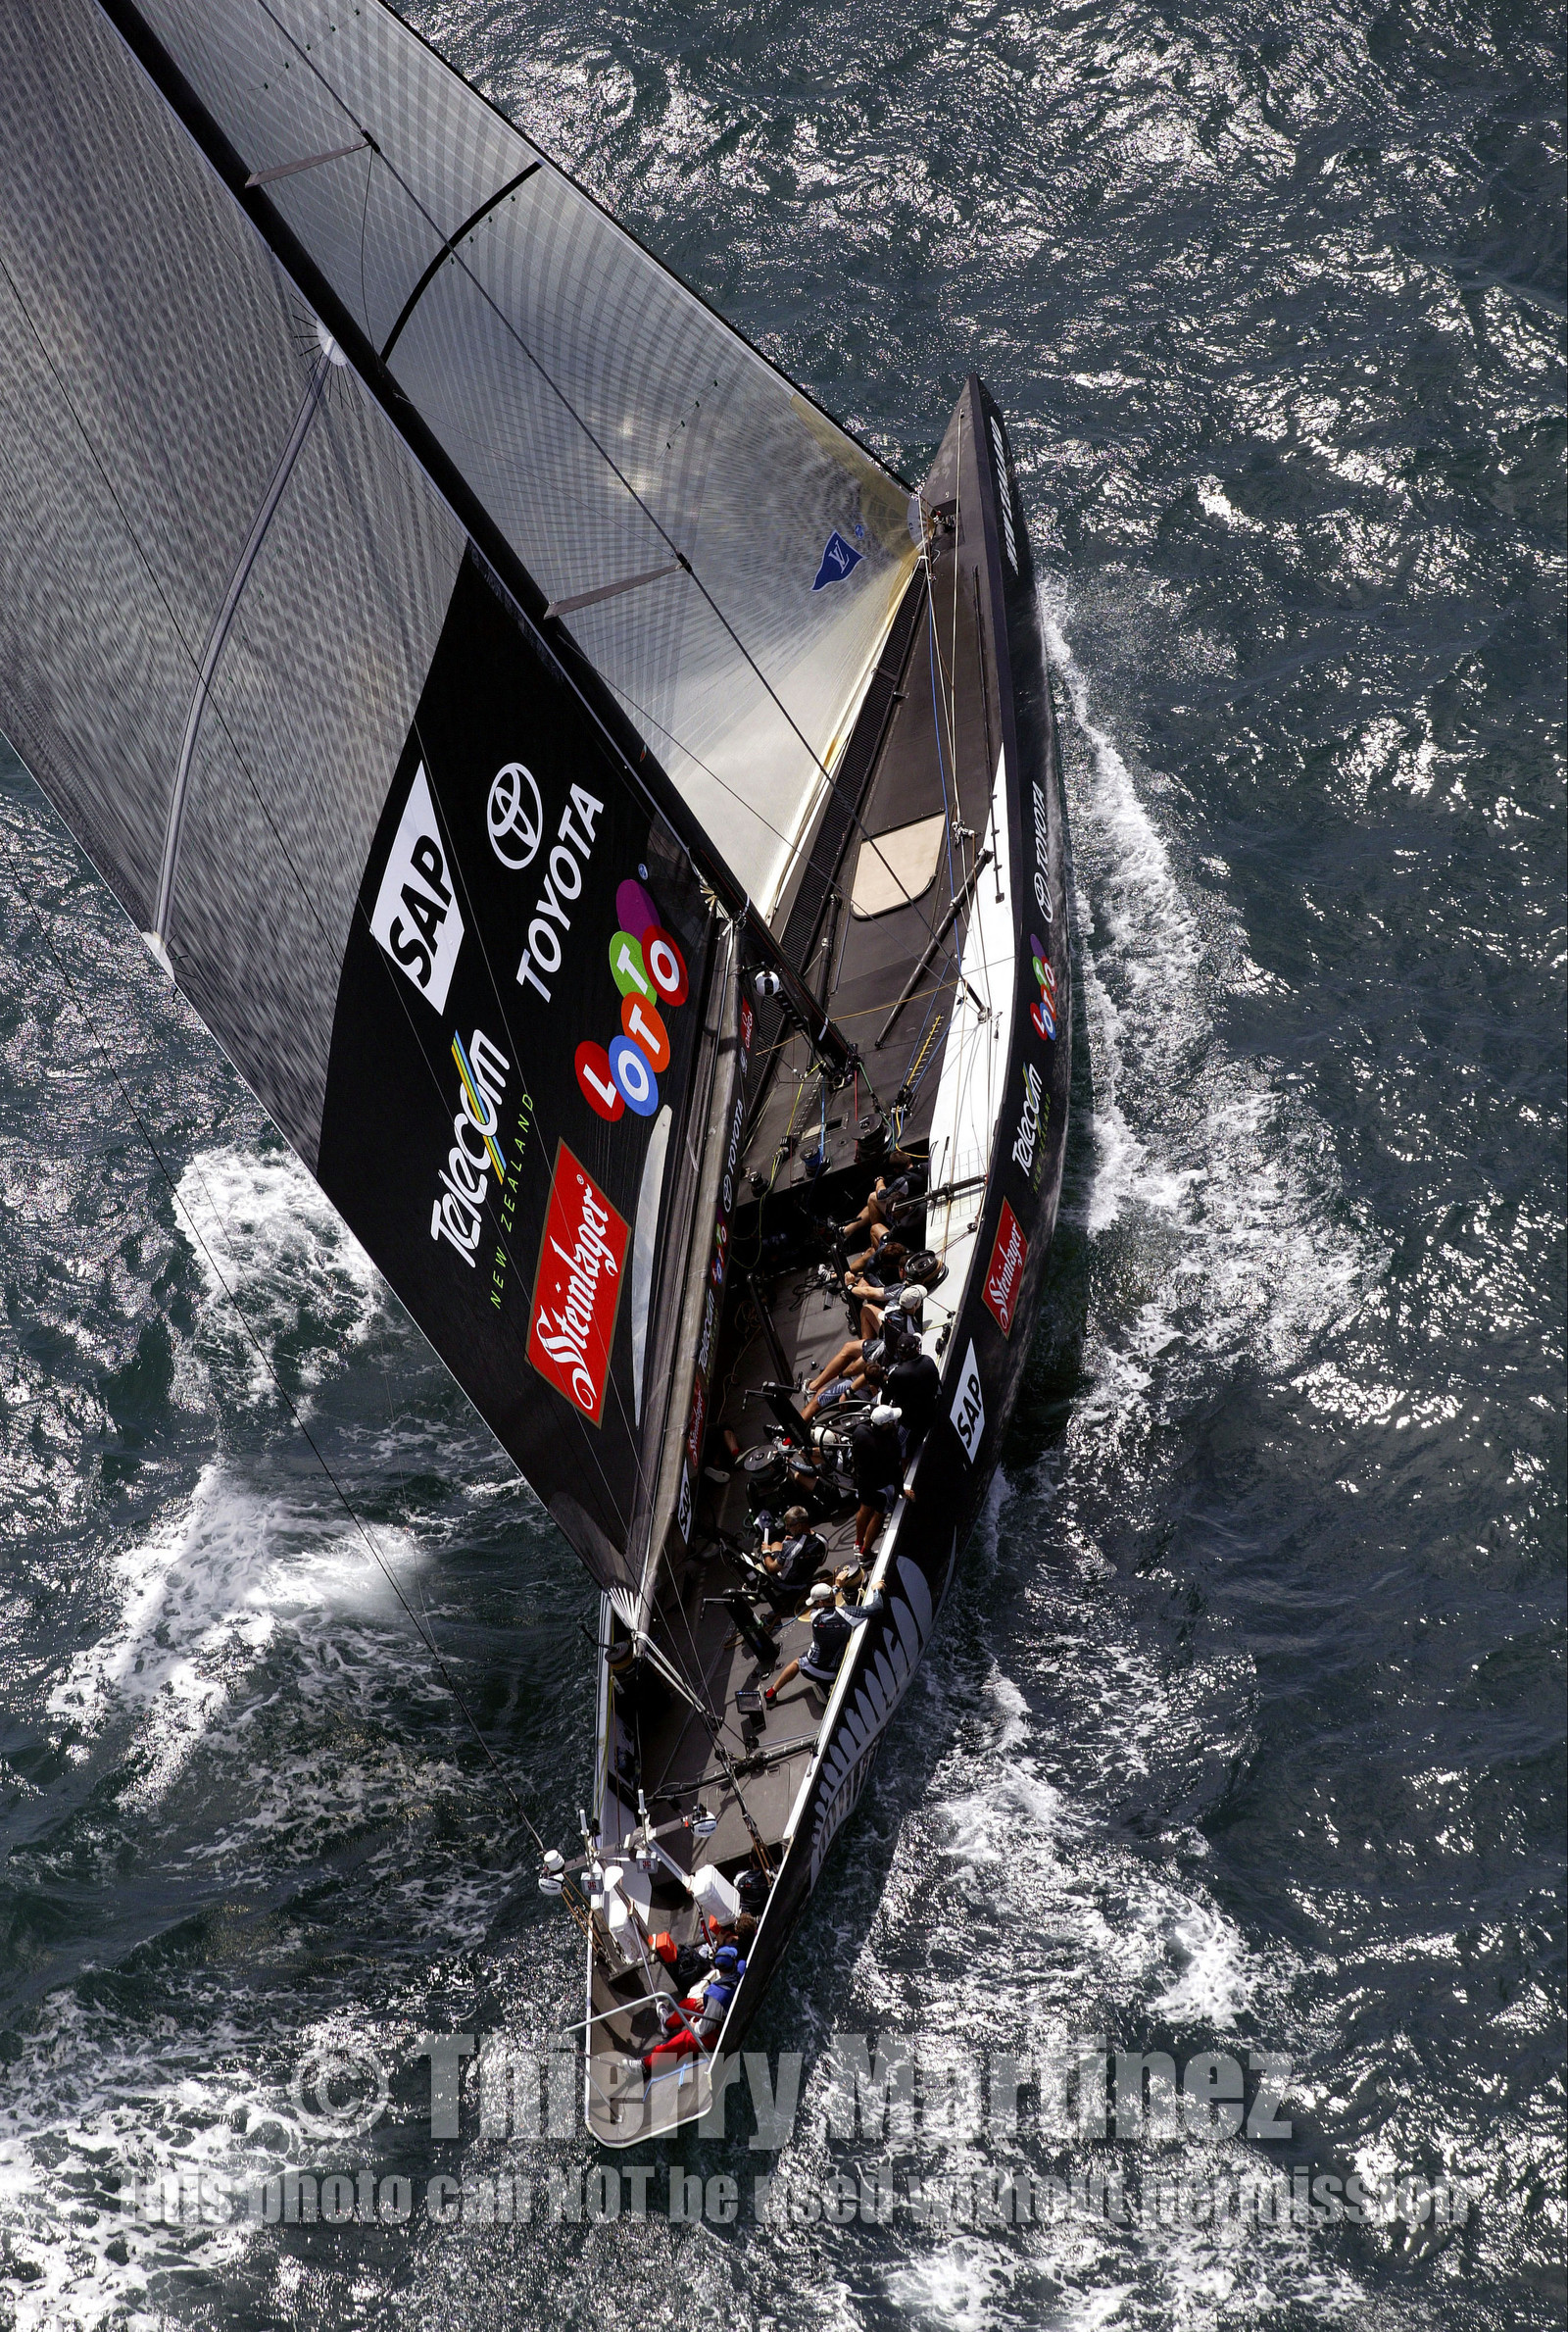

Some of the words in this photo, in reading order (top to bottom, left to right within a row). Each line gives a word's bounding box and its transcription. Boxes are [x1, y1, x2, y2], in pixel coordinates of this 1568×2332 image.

[515, 783, 604, 1003] TOYOTA
[1032, 780, 1049, 876] TOYOTA
[389, 834, 453, 989] SAP
[582, 939, 680, 1110] LOTTO
[1033, 962, 1055, 1034] LOTTO
[430, 1029, 511, 1268] Telecom
[728, 1098, 744, 1175] TOYOTA
[1011, 1063, 1043, 1177] Telecom
[490, 1246, 508, 1310] NEW
[501, 1093, 534, 1233] ZEALAND
[536, 1183, 618, 1411] Steinlager
[988, 1221, 1023, 1330] Steinlager
[956, 1373, 983, 1450] SAP
